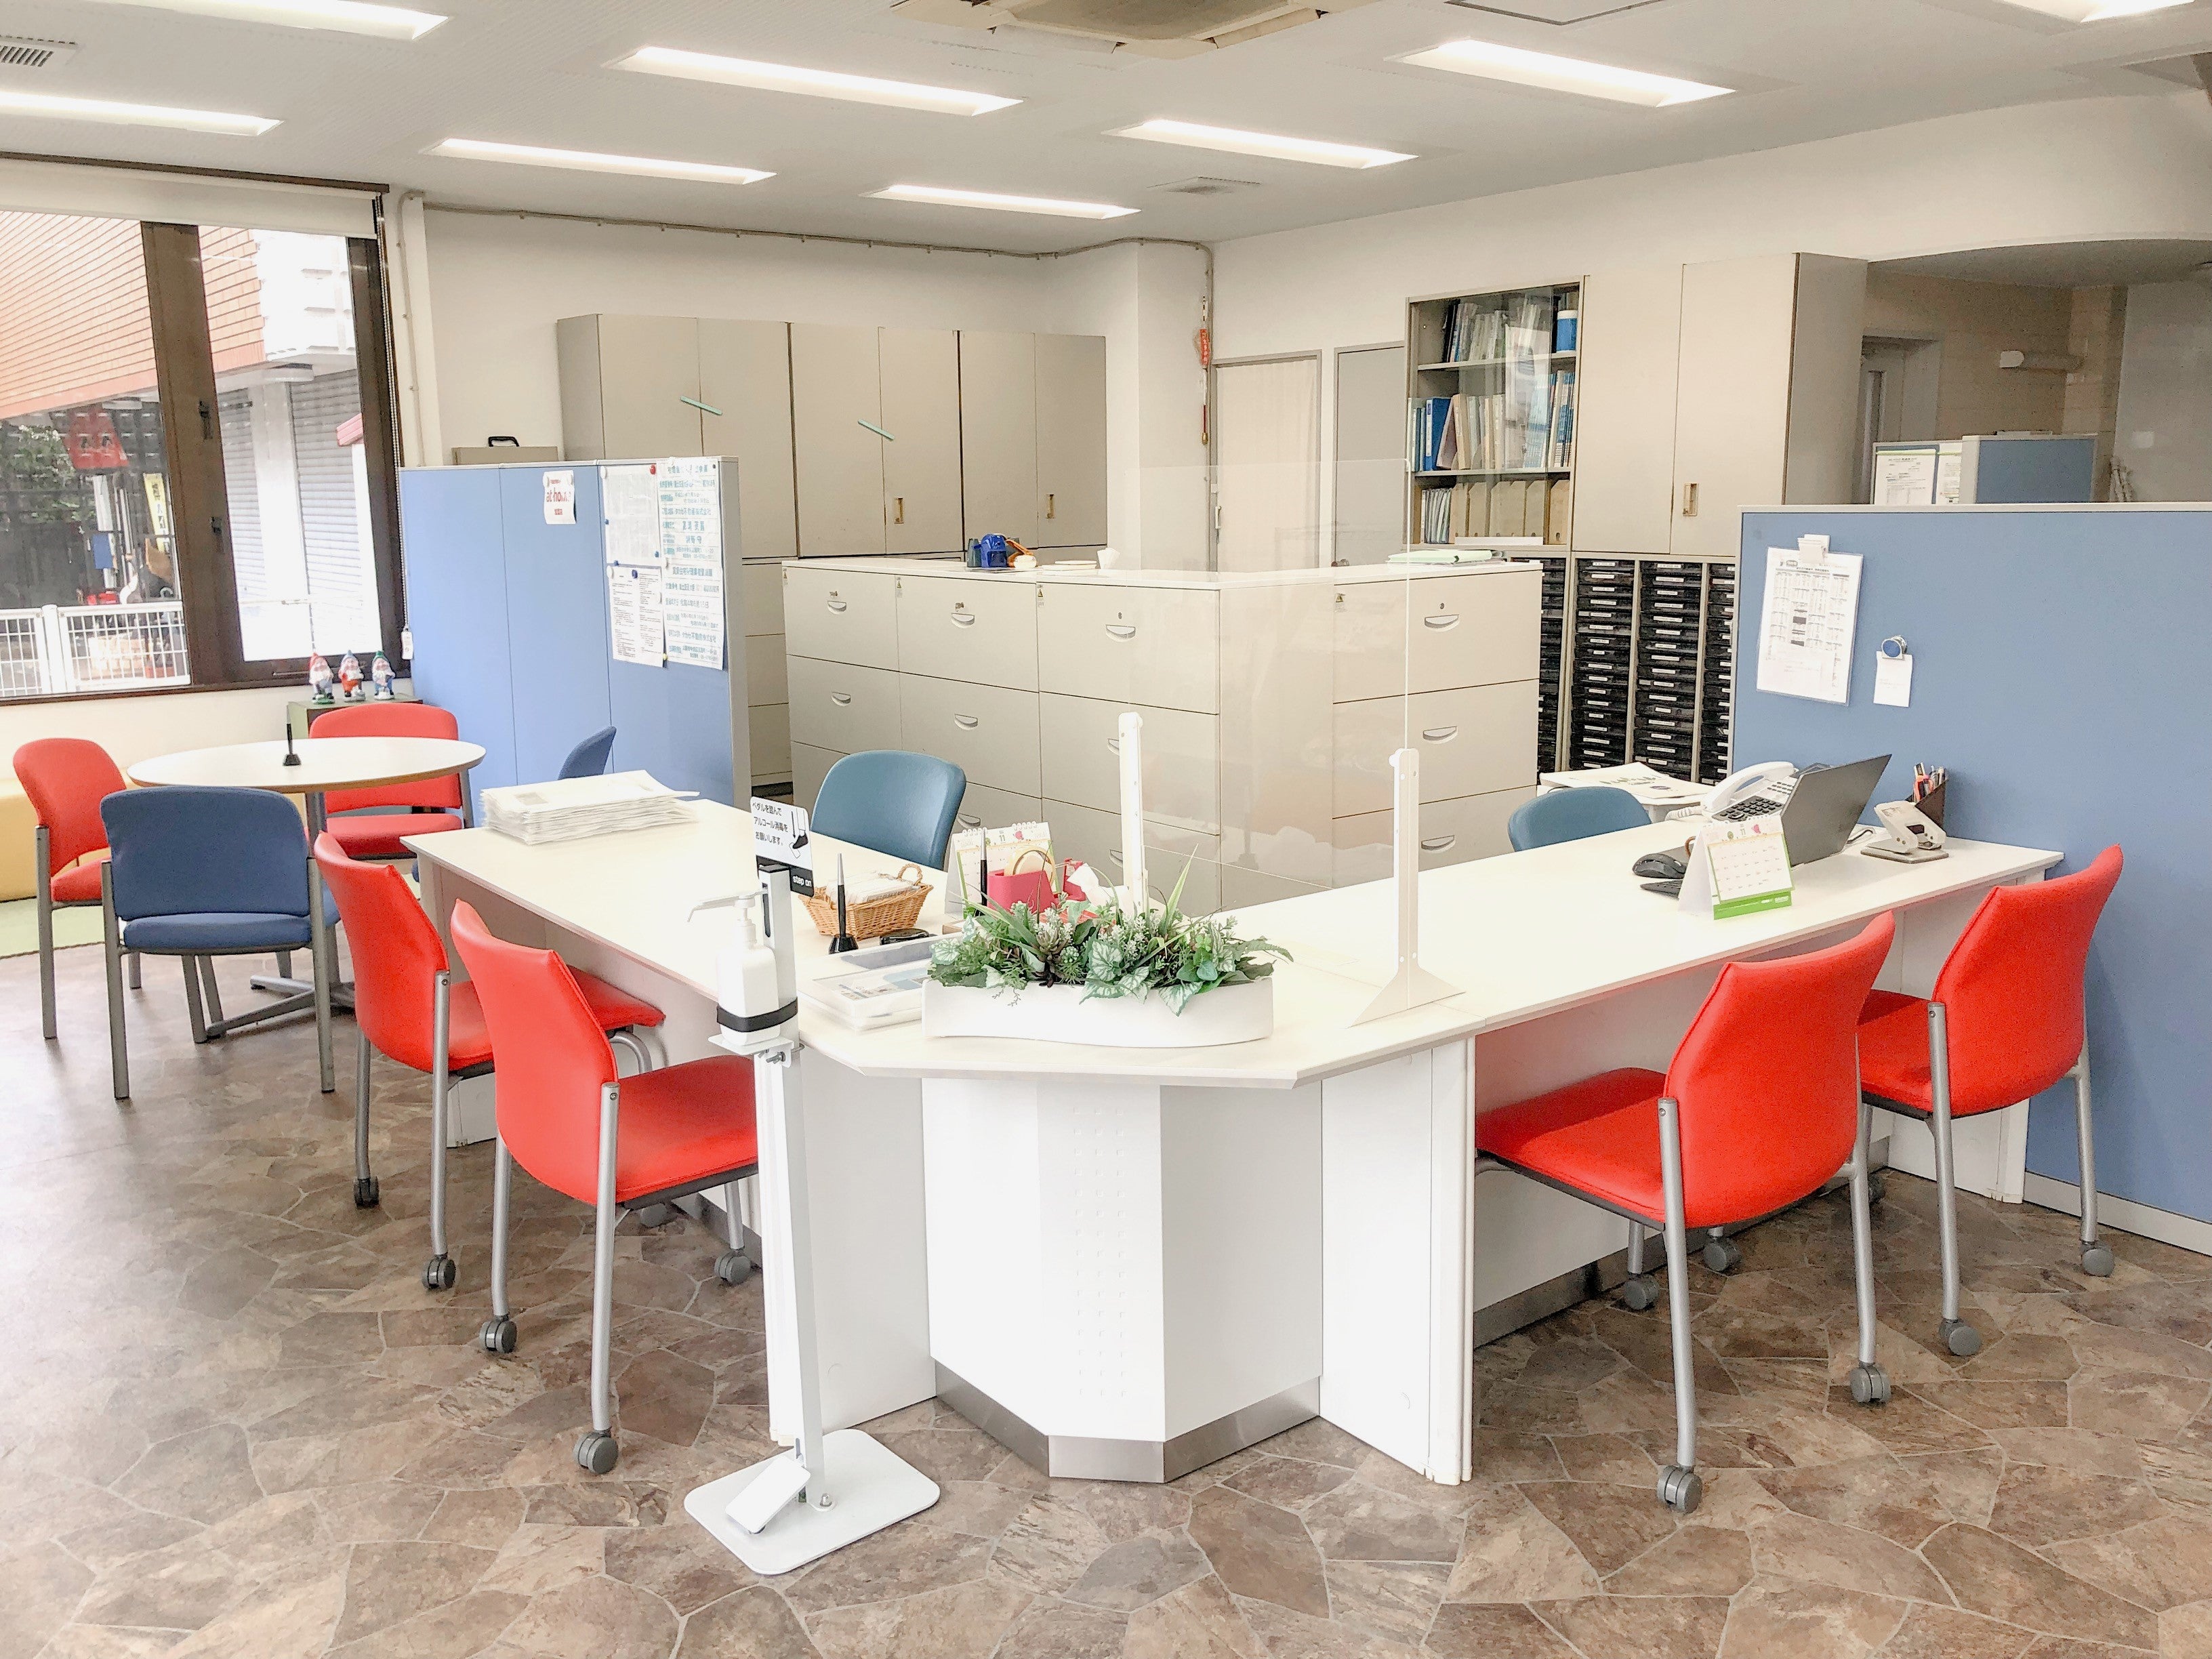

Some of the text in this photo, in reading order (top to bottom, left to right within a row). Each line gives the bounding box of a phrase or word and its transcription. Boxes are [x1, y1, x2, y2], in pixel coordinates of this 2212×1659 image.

[752, 802, 782, 816] ペダルを踏んで
[754, 817, 788, 833] アルコール消毒を
[755, 832, 783, 846] お願いします。
[792, 875, 812, 887] step on
